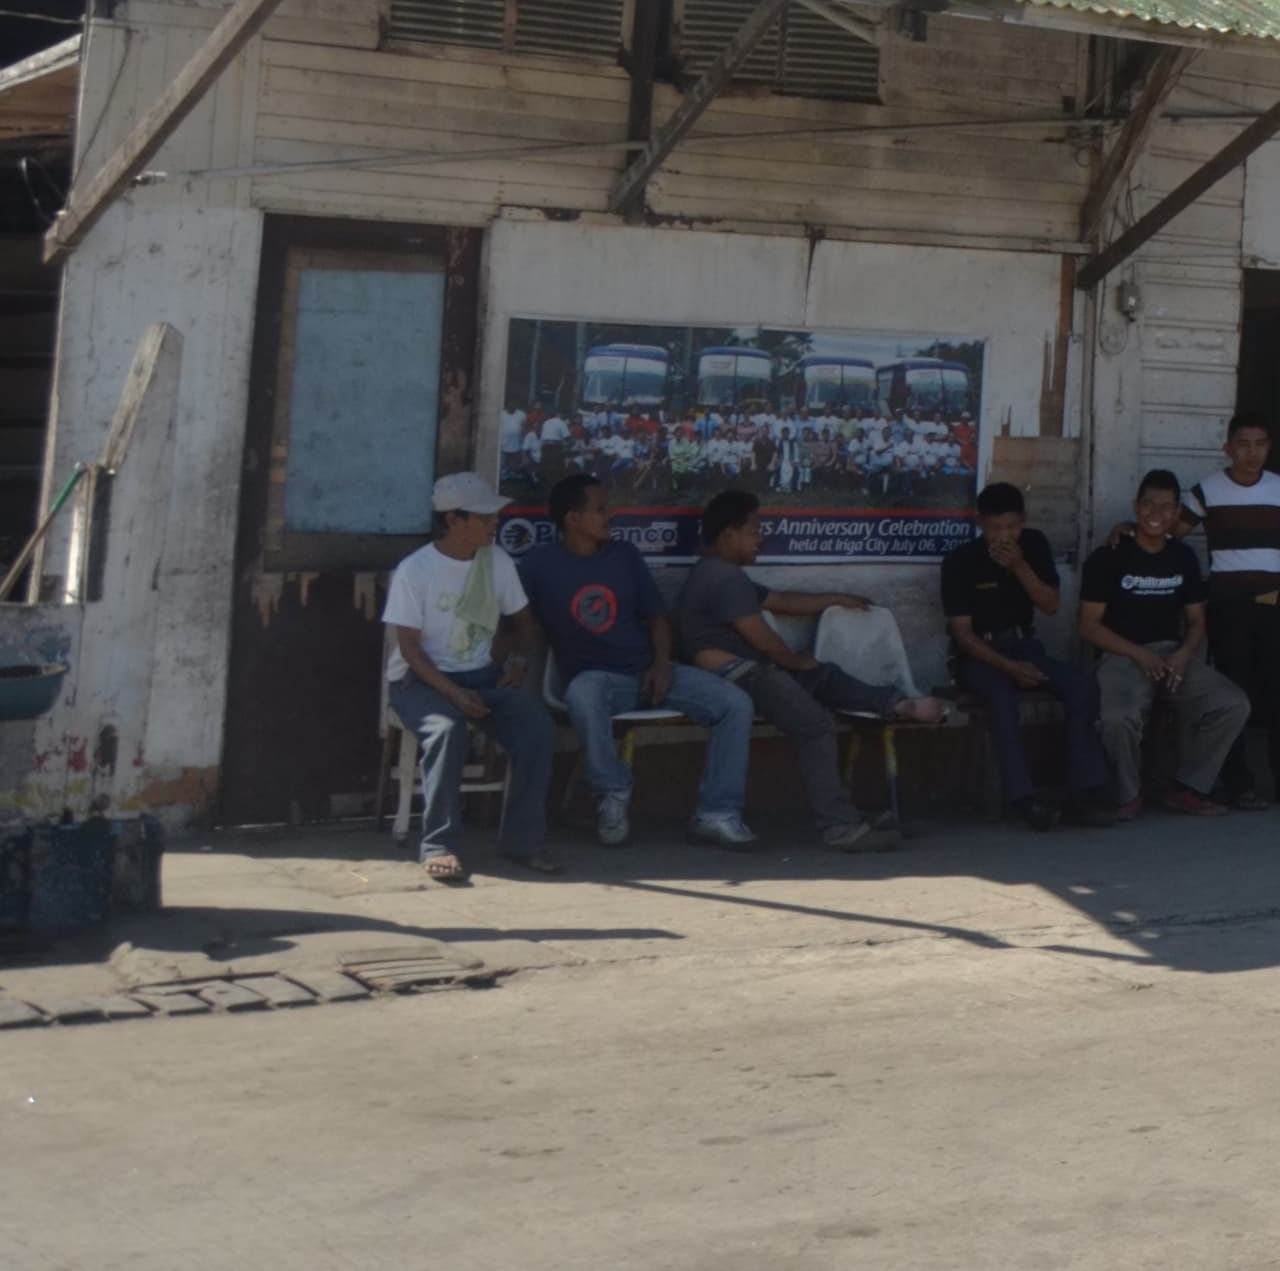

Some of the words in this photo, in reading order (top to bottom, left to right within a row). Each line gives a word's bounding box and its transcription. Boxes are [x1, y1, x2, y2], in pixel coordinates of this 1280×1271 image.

[775, 517, 876, 541] Anniversary
[878, 518, 971, 536] Celebration
[788, 538, 818, 551] held
[819, 539, 833, 551] at
[835, 538, 863, 555] Iriga
[865, 538, 890, 555] City
[891, 537, 916, 555] July
